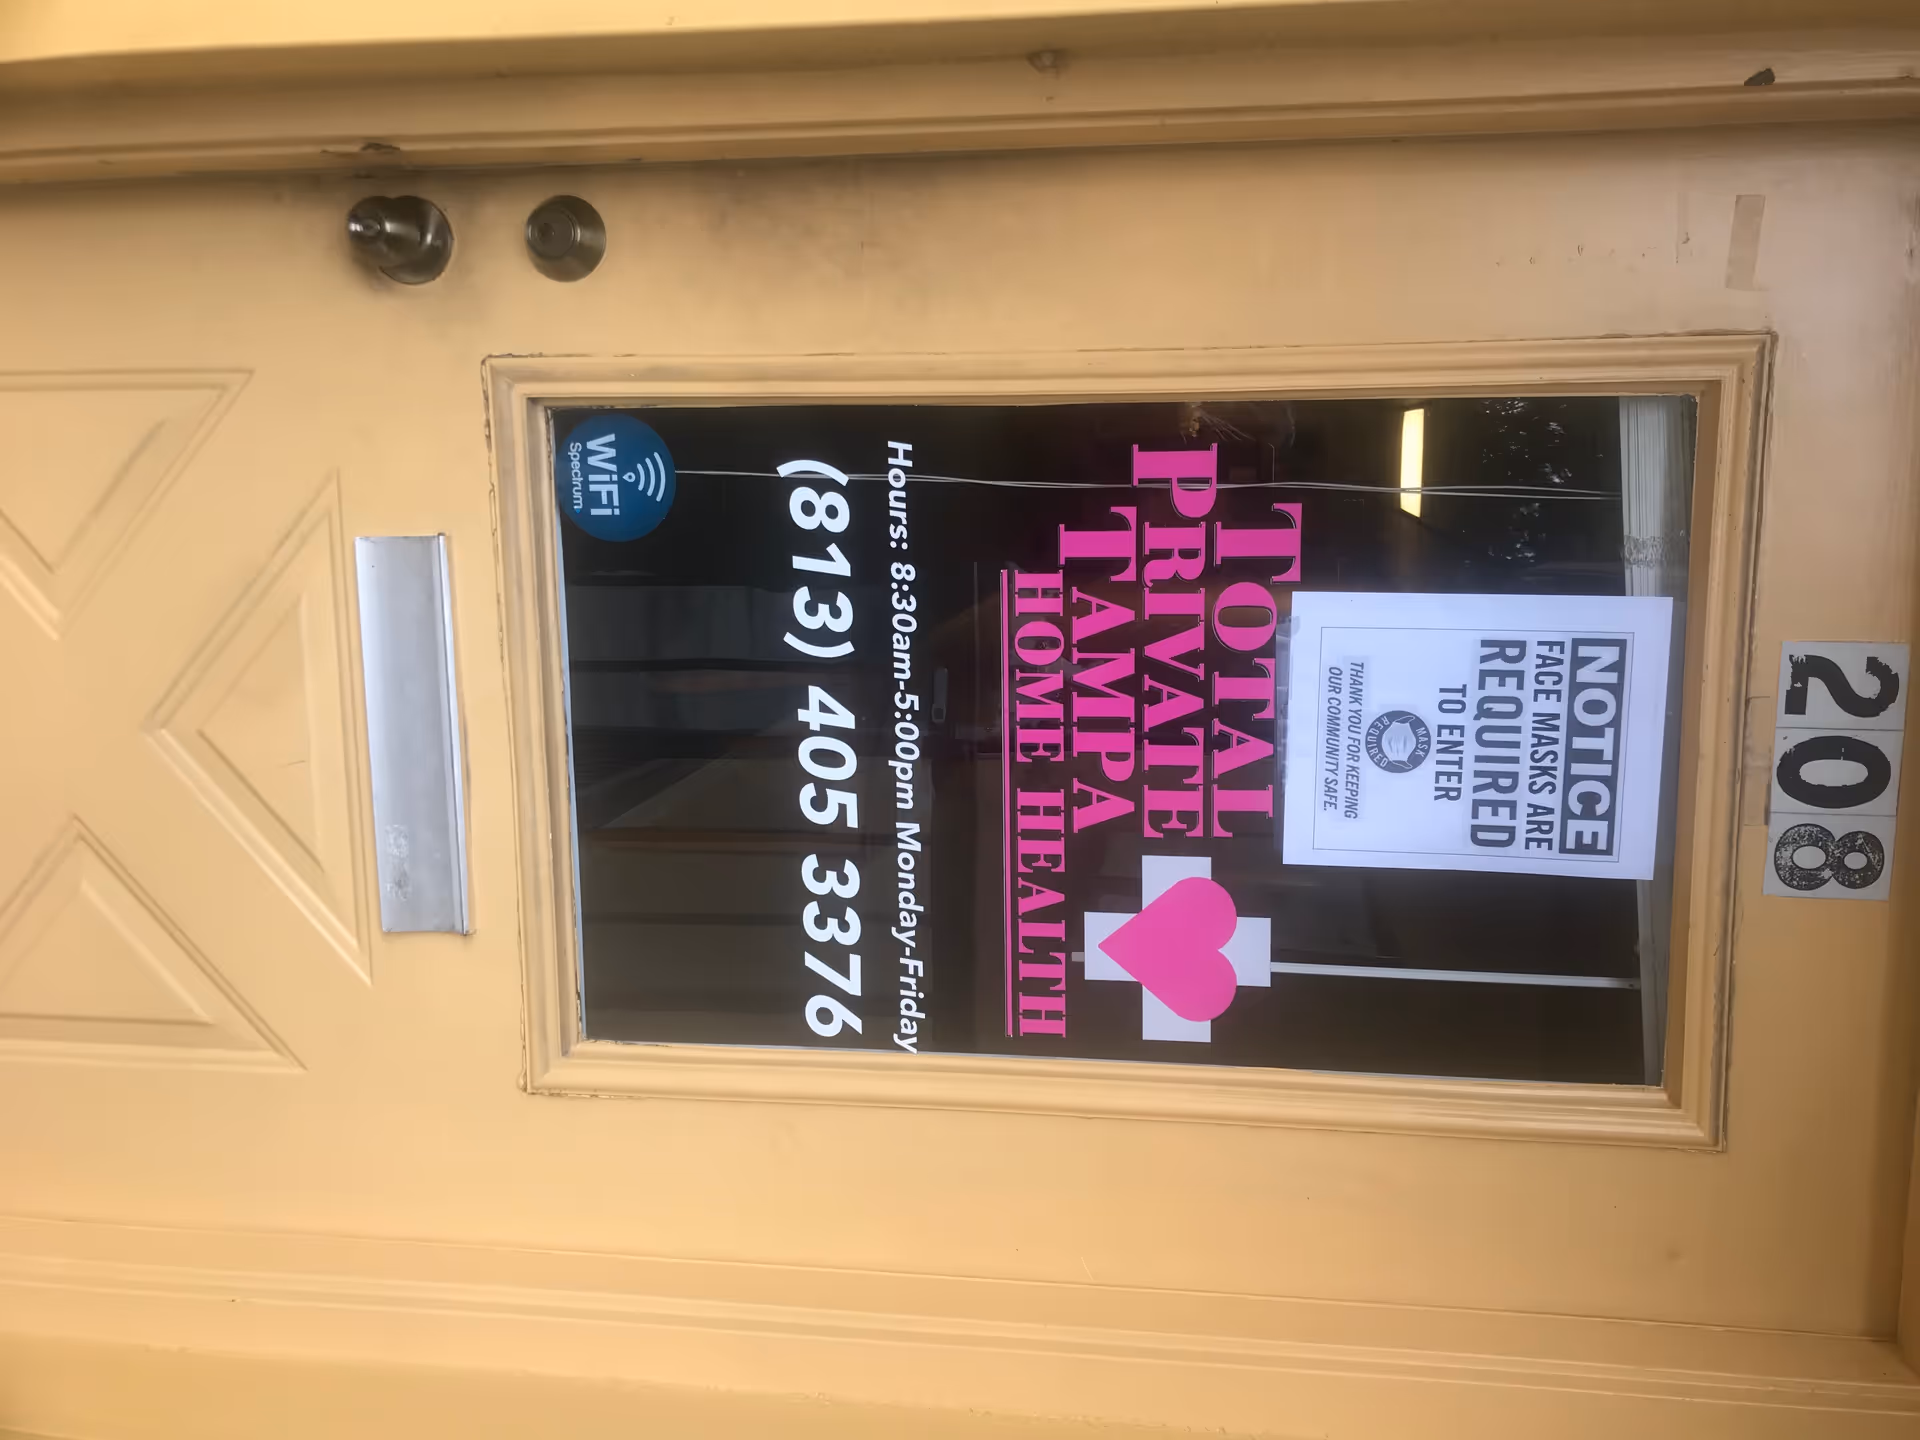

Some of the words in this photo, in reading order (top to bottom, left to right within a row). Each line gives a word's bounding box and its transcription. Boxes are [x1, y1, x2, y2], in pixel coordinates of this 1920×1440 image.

[568, 442, 583, 509] Spectrum
[586, 433, 620, 516] WiFi
[887, 440, 914, 551] Hours:
[776, 459, 856, 659] (813)
[1014, 569, 1065, 763] HOME
[1057, 505, 1138, 834] TAMPA
[1132, 442, 1218, 839] PRIVATE
[1212, 502, 1303, 838] TOTAL
[1328, 666, 1343, 695] OUR
[1532, 640, 1566, 704] FACE
[888, 561, 921, 810] 8:30am-5:00pm
[1347, 708, 1362, 735] YOU
[1348, 662, 1364, 706] THANK
[1437, 684, 1468, 714] TO
[797, 685, 860, 829] 405
[1324, 697, 1342, 777] COMMUNITY
[1346, 736, 1361, 762] FOR
[1367, 715, 1390, 768] REQUIRED
[1415, 727, 1429, 758] MASK
[1433, 723, 1465, 802] ENTER
[1470, 639, 1527, 848] REQUIRED
[1527, 712, 1560, 796] MASKS
[1565, 645, 1620, 851] NOTICE
[1774, 653, 1900, 891] 208
[1323, 777, 1339, 811] SAFE.
[1344, 764, 1360, 819] KEEPING
[1524, 802, 1555, 851] ARE
[801, 853, 864, 1038] 3376
[891, 821, 926, 1056] Monday-Friday
[1016, 788, 1067, 1038] HEALTH
